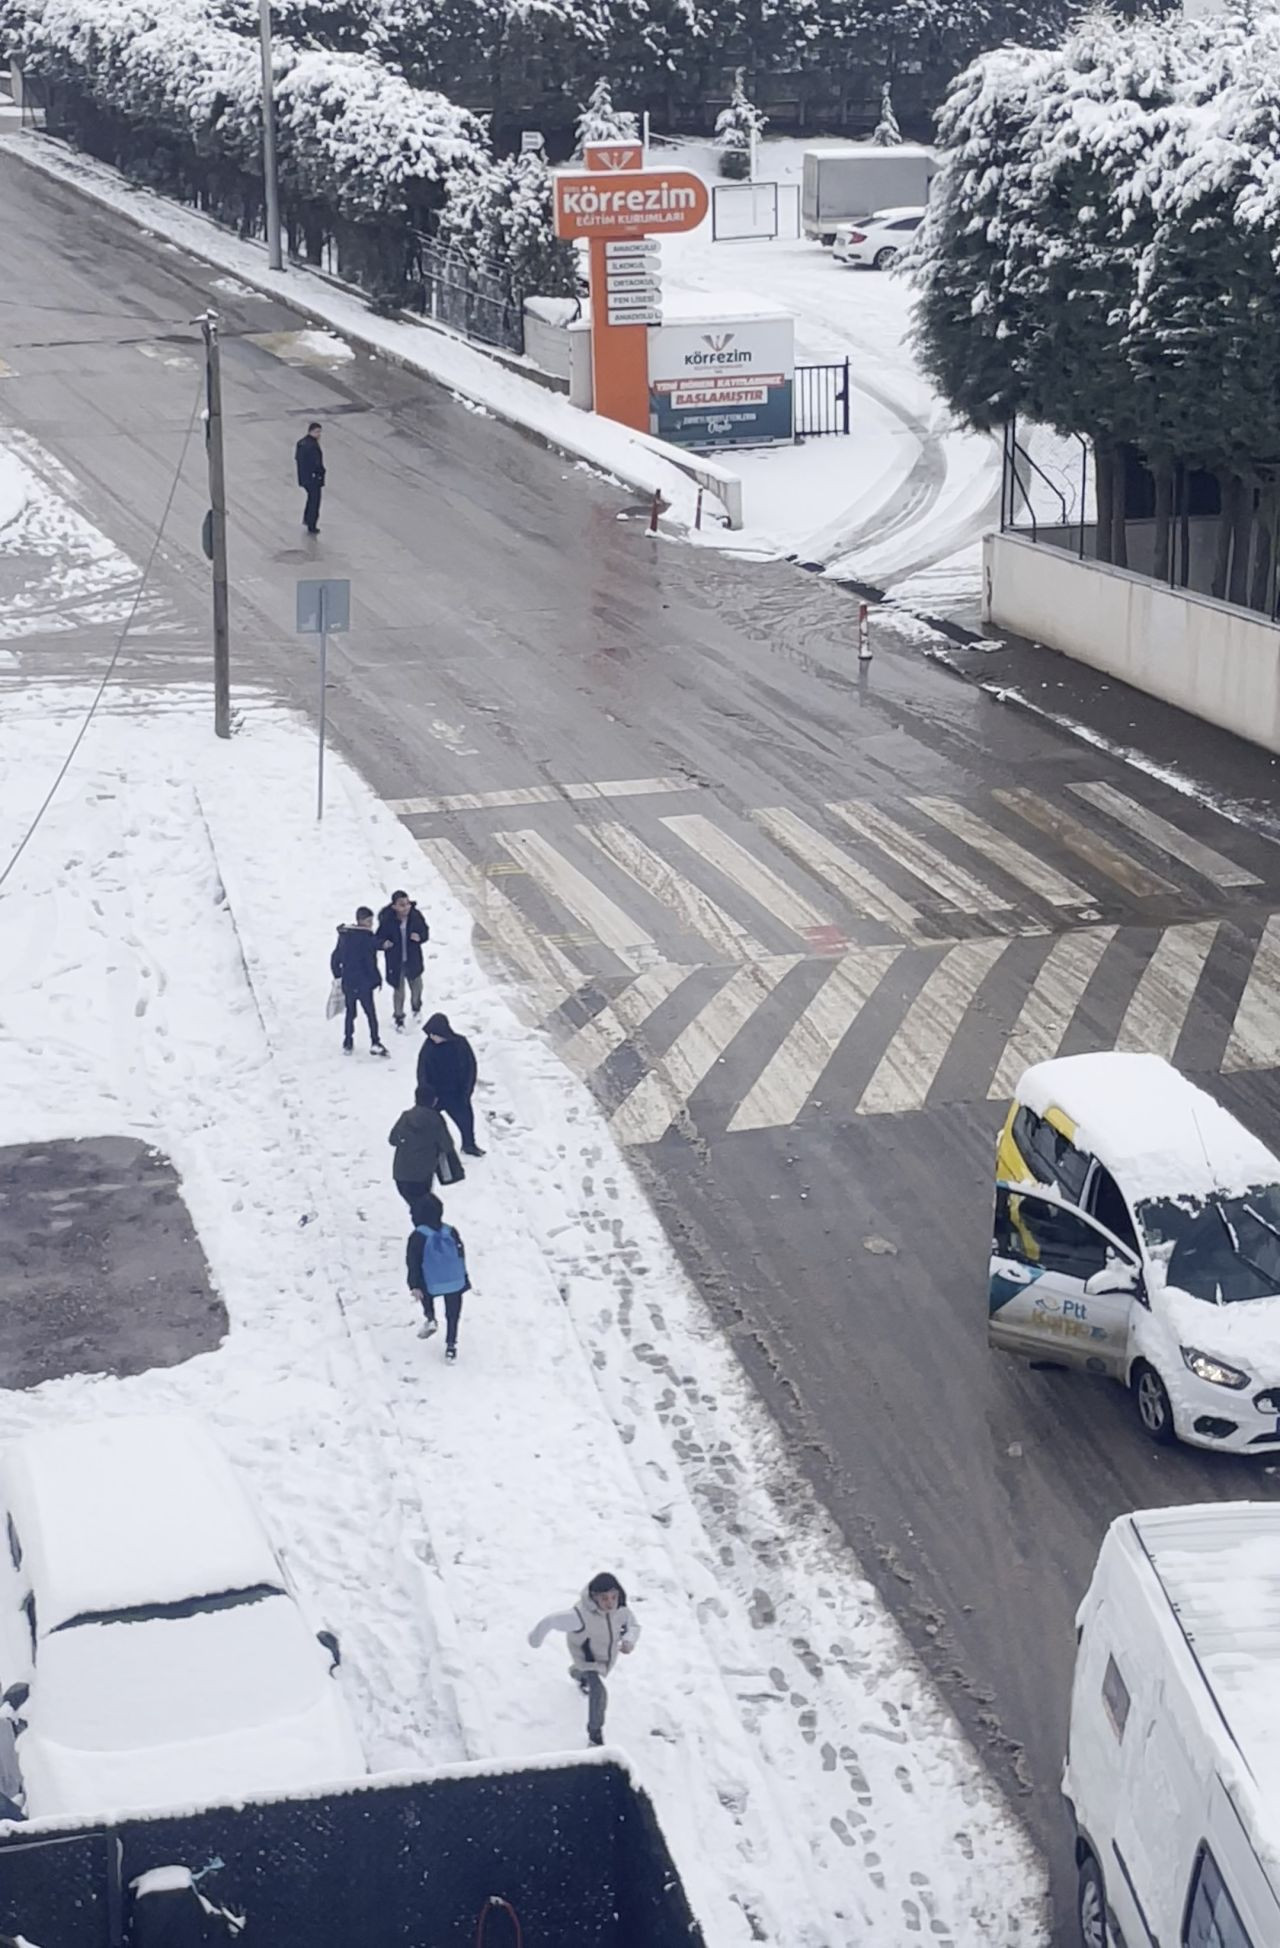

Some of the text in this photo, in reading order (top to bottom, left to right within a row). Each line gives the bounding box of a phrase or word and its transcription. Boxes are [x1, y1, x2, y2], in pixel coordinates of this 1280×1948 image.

[575, 211, 685, 227] EĞİTİM KURUMLARI
[675, 389, 764, 406] BAŞLAMIŞTIR
[1062, 1300, 1088, 1320] Ptt
